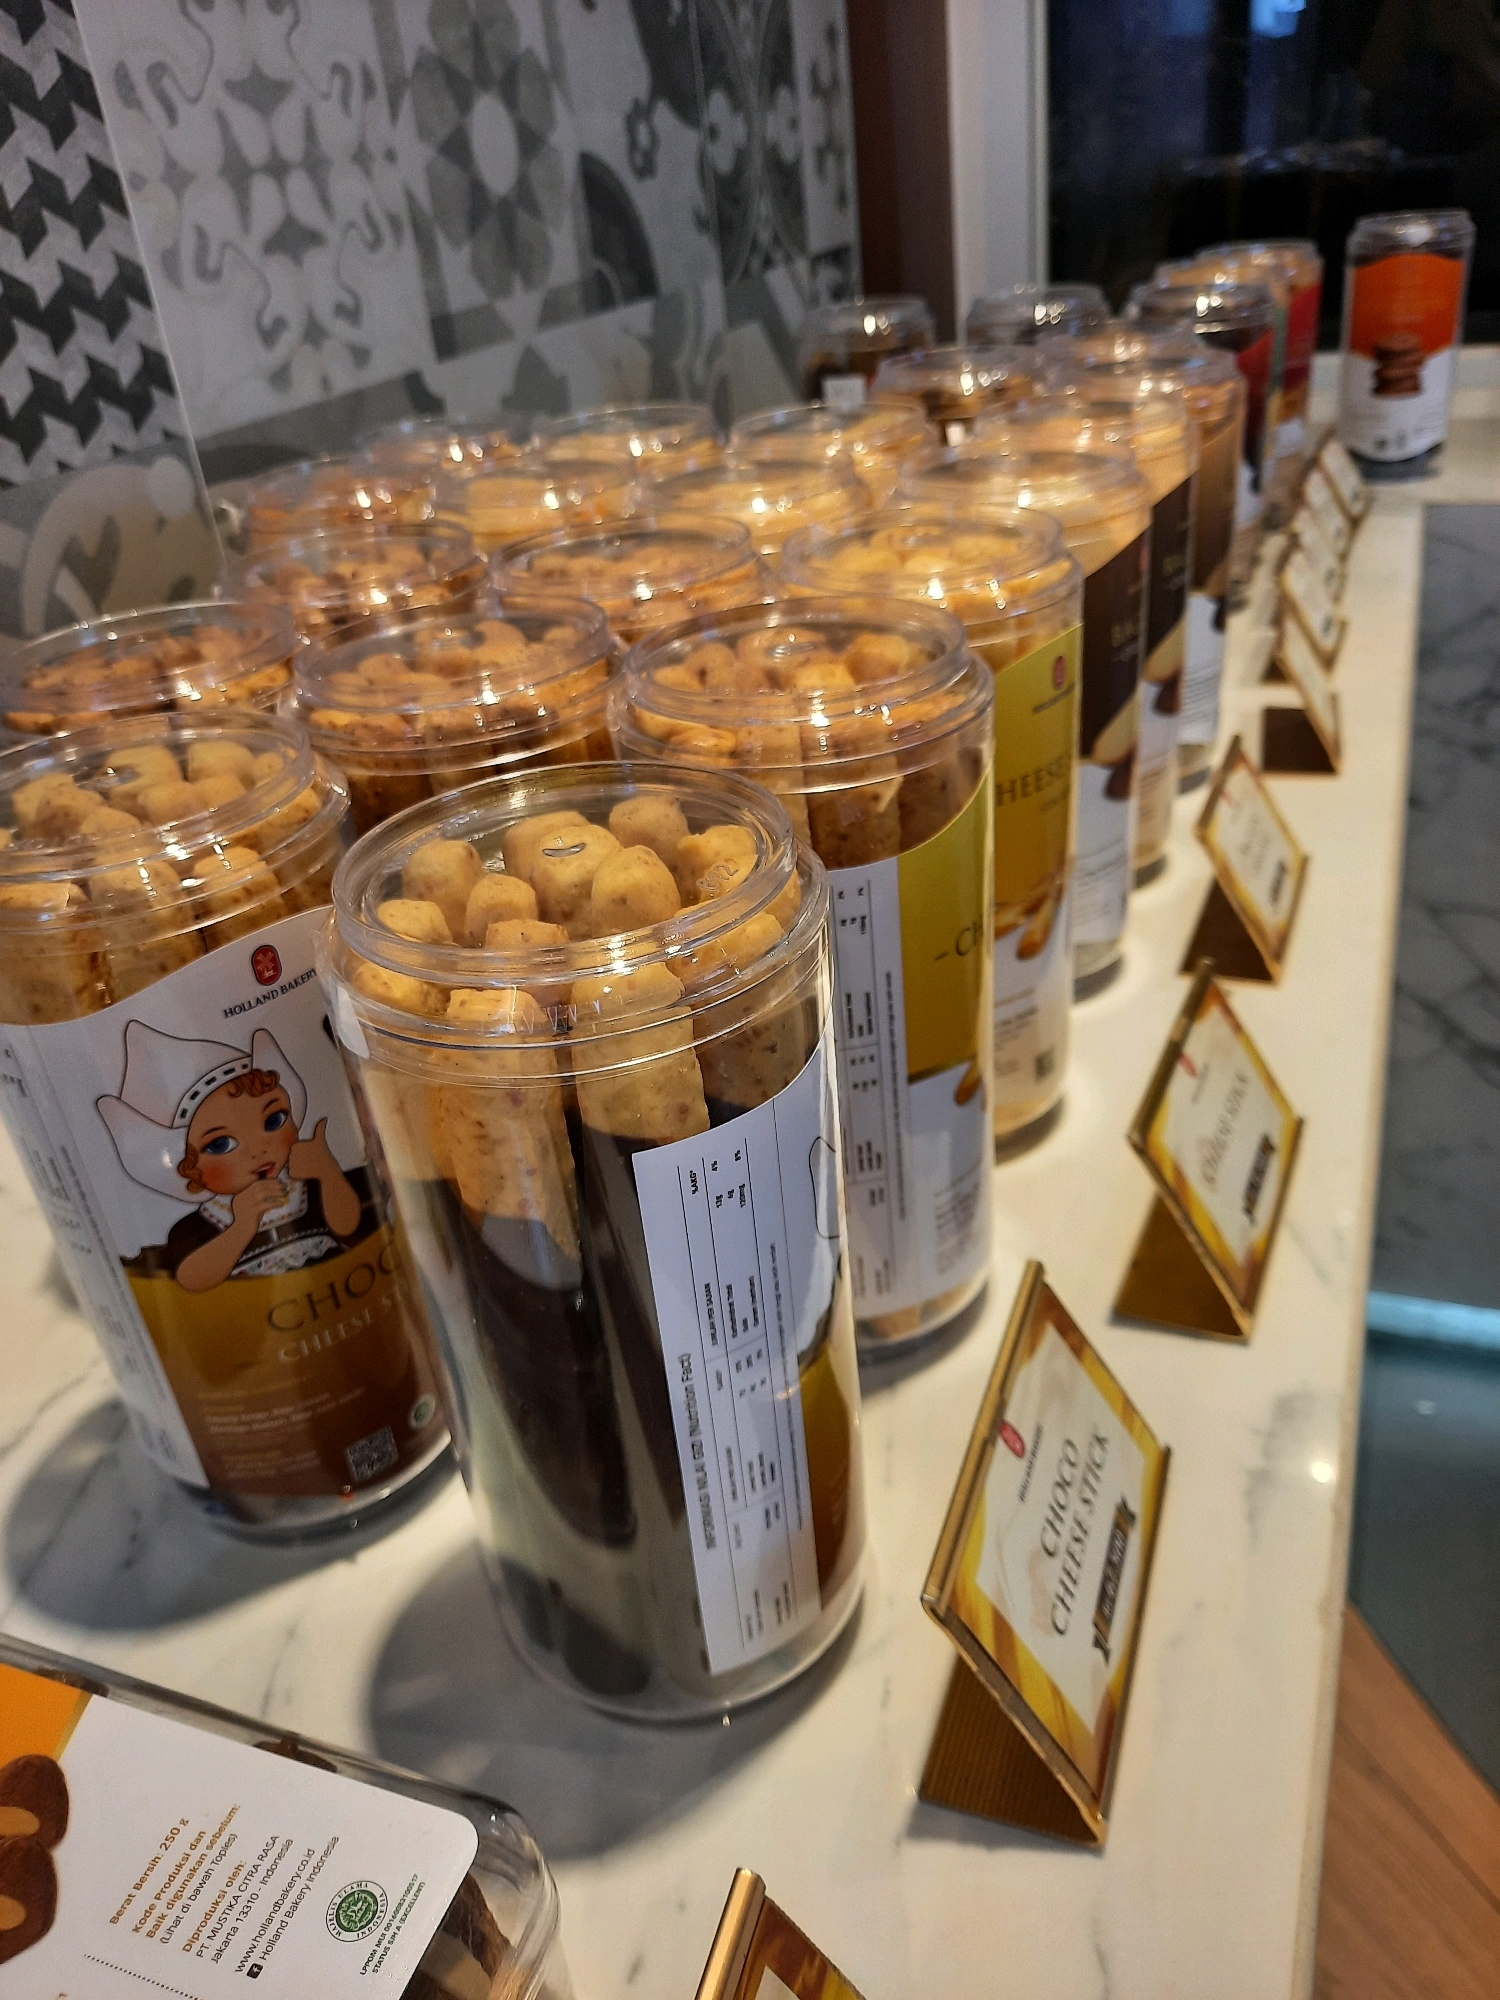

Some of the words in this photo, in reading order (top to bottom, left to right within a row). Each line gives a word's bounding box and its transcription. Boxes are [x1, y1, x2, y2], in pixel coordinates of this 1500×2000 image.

[222, 985, 281, 1021] HOLLAND
[1040, 1438, 1081, 1559] CHOCO
[1049, 1513, 1094, 1638] CHEESE
[1078, 1432, 1111, 1527] STICK
[109, 1893, 136, 1925] Berat
[133, 1852, 164, 1892] Bersih:
[159, 1827, 181, 1852] 250
[179, 1817, 190, 1827] g
[132, 1903, 157, 1934] Kode
[154, 1852, 191, 1901] Produksi
[190, 1830, 206, 1851] dan
[146, 1912, 168, 1939] Baik
[166, 1852, 208, 1910] digunakan
[206, 1803, 241, 1851] sebelum:
[160, 1914, 185, 1944] (Lihat
[181, 1897, 192, 1914] di
[187, 1868, 215, 1902] bawah
[209, 1833, 238, 1868] Toples)
[182, 1889, 228, 1953] Diproduksi
[226, 1860, 246, 1888] oleh:
[196, 1942, 212, 1958] PT.
[206, 1894, 242, 1941] MUSTIKA
[238, 1864, 262, 1894] CITRA
[257, 1835, 280, 1863] RASA
[211, 1925, 239, 1965] Jakarta
[235, 1892, 260, 1924] 13310
[259, 1838, 294, 1887] Indonesia
[235, 1848, 316, 1974] www.hollandbakery.co.id
[259, 1918, 290, 1961] Holland
[284, 1883, 311, 1919] Bakery
[308, 1835, 340, 1883] Indonesia
[372, 1946, 391, 1974] STATUS
[399, 1881, 426, 1925] (EXCELLENT)
